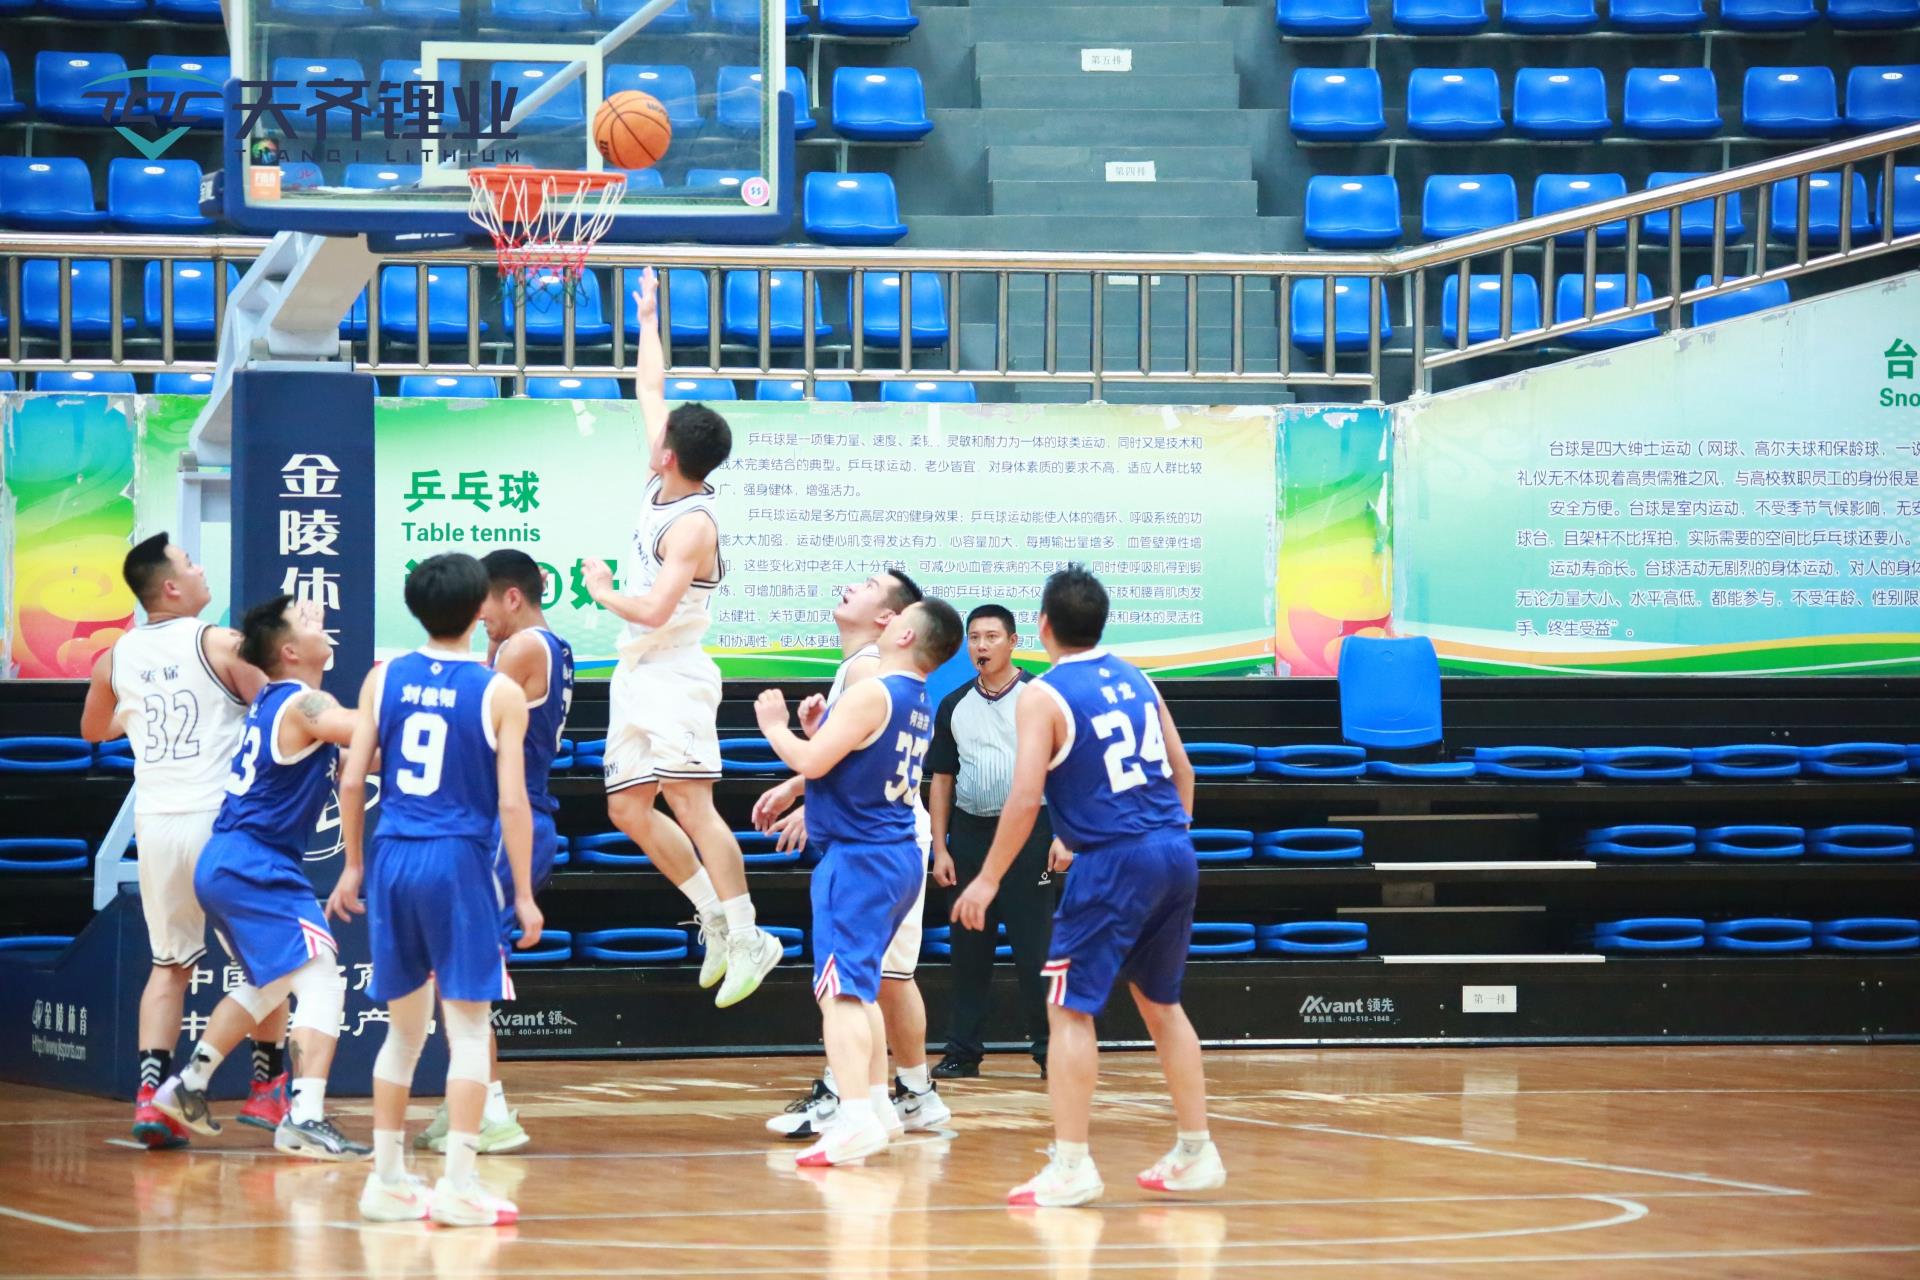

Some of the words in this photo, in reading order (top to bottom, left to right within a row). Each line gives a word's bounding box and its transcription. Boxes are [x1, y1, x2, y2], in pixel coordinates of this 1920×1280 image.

[1884, 338, 1918, 379] 台
[1880, 387, 1920, 407] Sno
[403, 469, 540, 513] 乒乓球
[401, 522, 464, 542] Table
[470, 523, 541, 542] tennis
[144, 689, 200, 763] 32
[396, 711, 448, 797] 9
[1091, 702, 1173, 793] 24
[1366, 997, 1394, 1012] 领先
